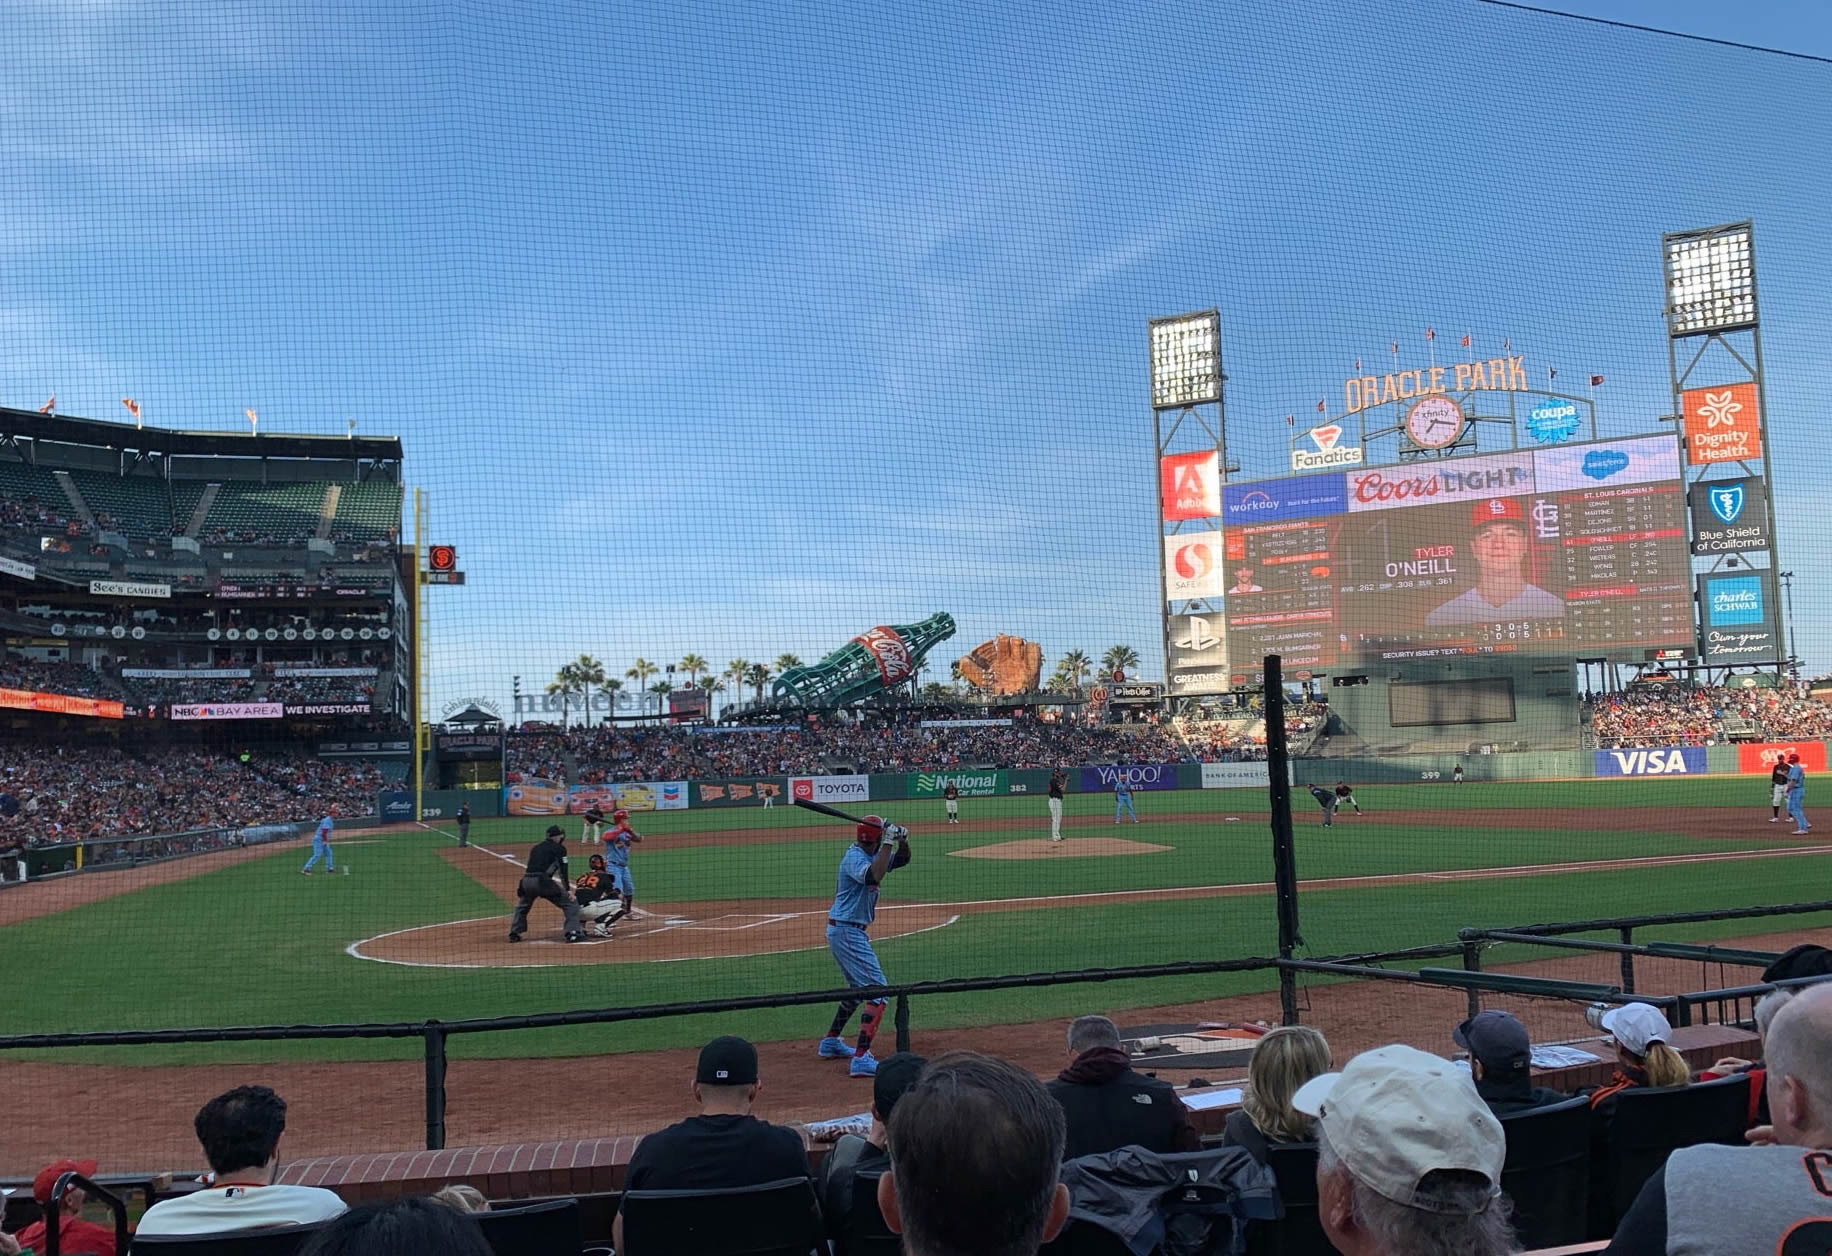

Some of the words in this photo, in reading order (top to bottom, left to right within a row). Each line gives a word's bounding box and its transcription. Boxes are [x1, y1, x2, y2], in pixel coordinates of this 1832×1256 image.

[1344, 367, 1446, 413] ORACLE
[1455, 356, 1529, 391] PARK
[1422, 410, 1449, 419] xfinity
[1532, 405, 1575, 420] coupa
[1694, 430, 1749, 447] Dignity
[1699, 443, 1749, 460] Health
[1295, 449, 1361, 468] Fanatics
[1354, 471, 1441, 502] Coors
[1442, 467, 1521, 493] LIGHT
[1230, 500, 1280, 512] workday
[1699, 531, 1724, 540] Blue
[1726, 526, 1760, 539] Shield
[1697, 540, 1709, 551] of
[1710, 536, 1766, 550] California
[1415, 546, 1454, 558] TYLER
[1385, 558, 1457, 578] O'NEILL
[93, 582, 124, 594] See's
[126, 587, 166, 596] CANDIES
[1357, 583, 1375, 591] .262
[1396, 580, 1414, 588] .308
[1436, 577, 1453, 585] .361
[1713, 589, 1757, 603] charles
[1714, 601, 1758, 613] SCHWAB
[1495, 623, 1502, 631] 3
[1508, 623, 1515, 631] 0
[1523, 630, 1530, 638] 5
[1708, 631, 1736, 643] Own
[1737, 632, 1769, 646] your
[1383, 651, 1414, 659] SECURITY
[1708, 644, 1772, 655] tomorrow
[1174, 673, 1226, 684] GREATNESS
[514, 691, 659, 713] nuveen
[174, 706, 200, 717] NBC
[216, 706, 242, 716] BAY
[243, 705, 280, 715] AREA
[285, 706, 304, 714] WE
[304, 704, 370, 714] INVESTIGATE
[1610, 750, 1687, 774] VISA
[935, 772, 997, 789] National
[1097, 765, 1161, 785] YAHOO!
[1238, 770, 1269, 778] AMERIC
[1421, 771, 1441, 780] 399
[818, 783, 865, 794] TOYOTA
[971, 788, 995, 796] Rental
[1009, 784, 1027, 792] 382
[421, 808, 442, 817] 339
